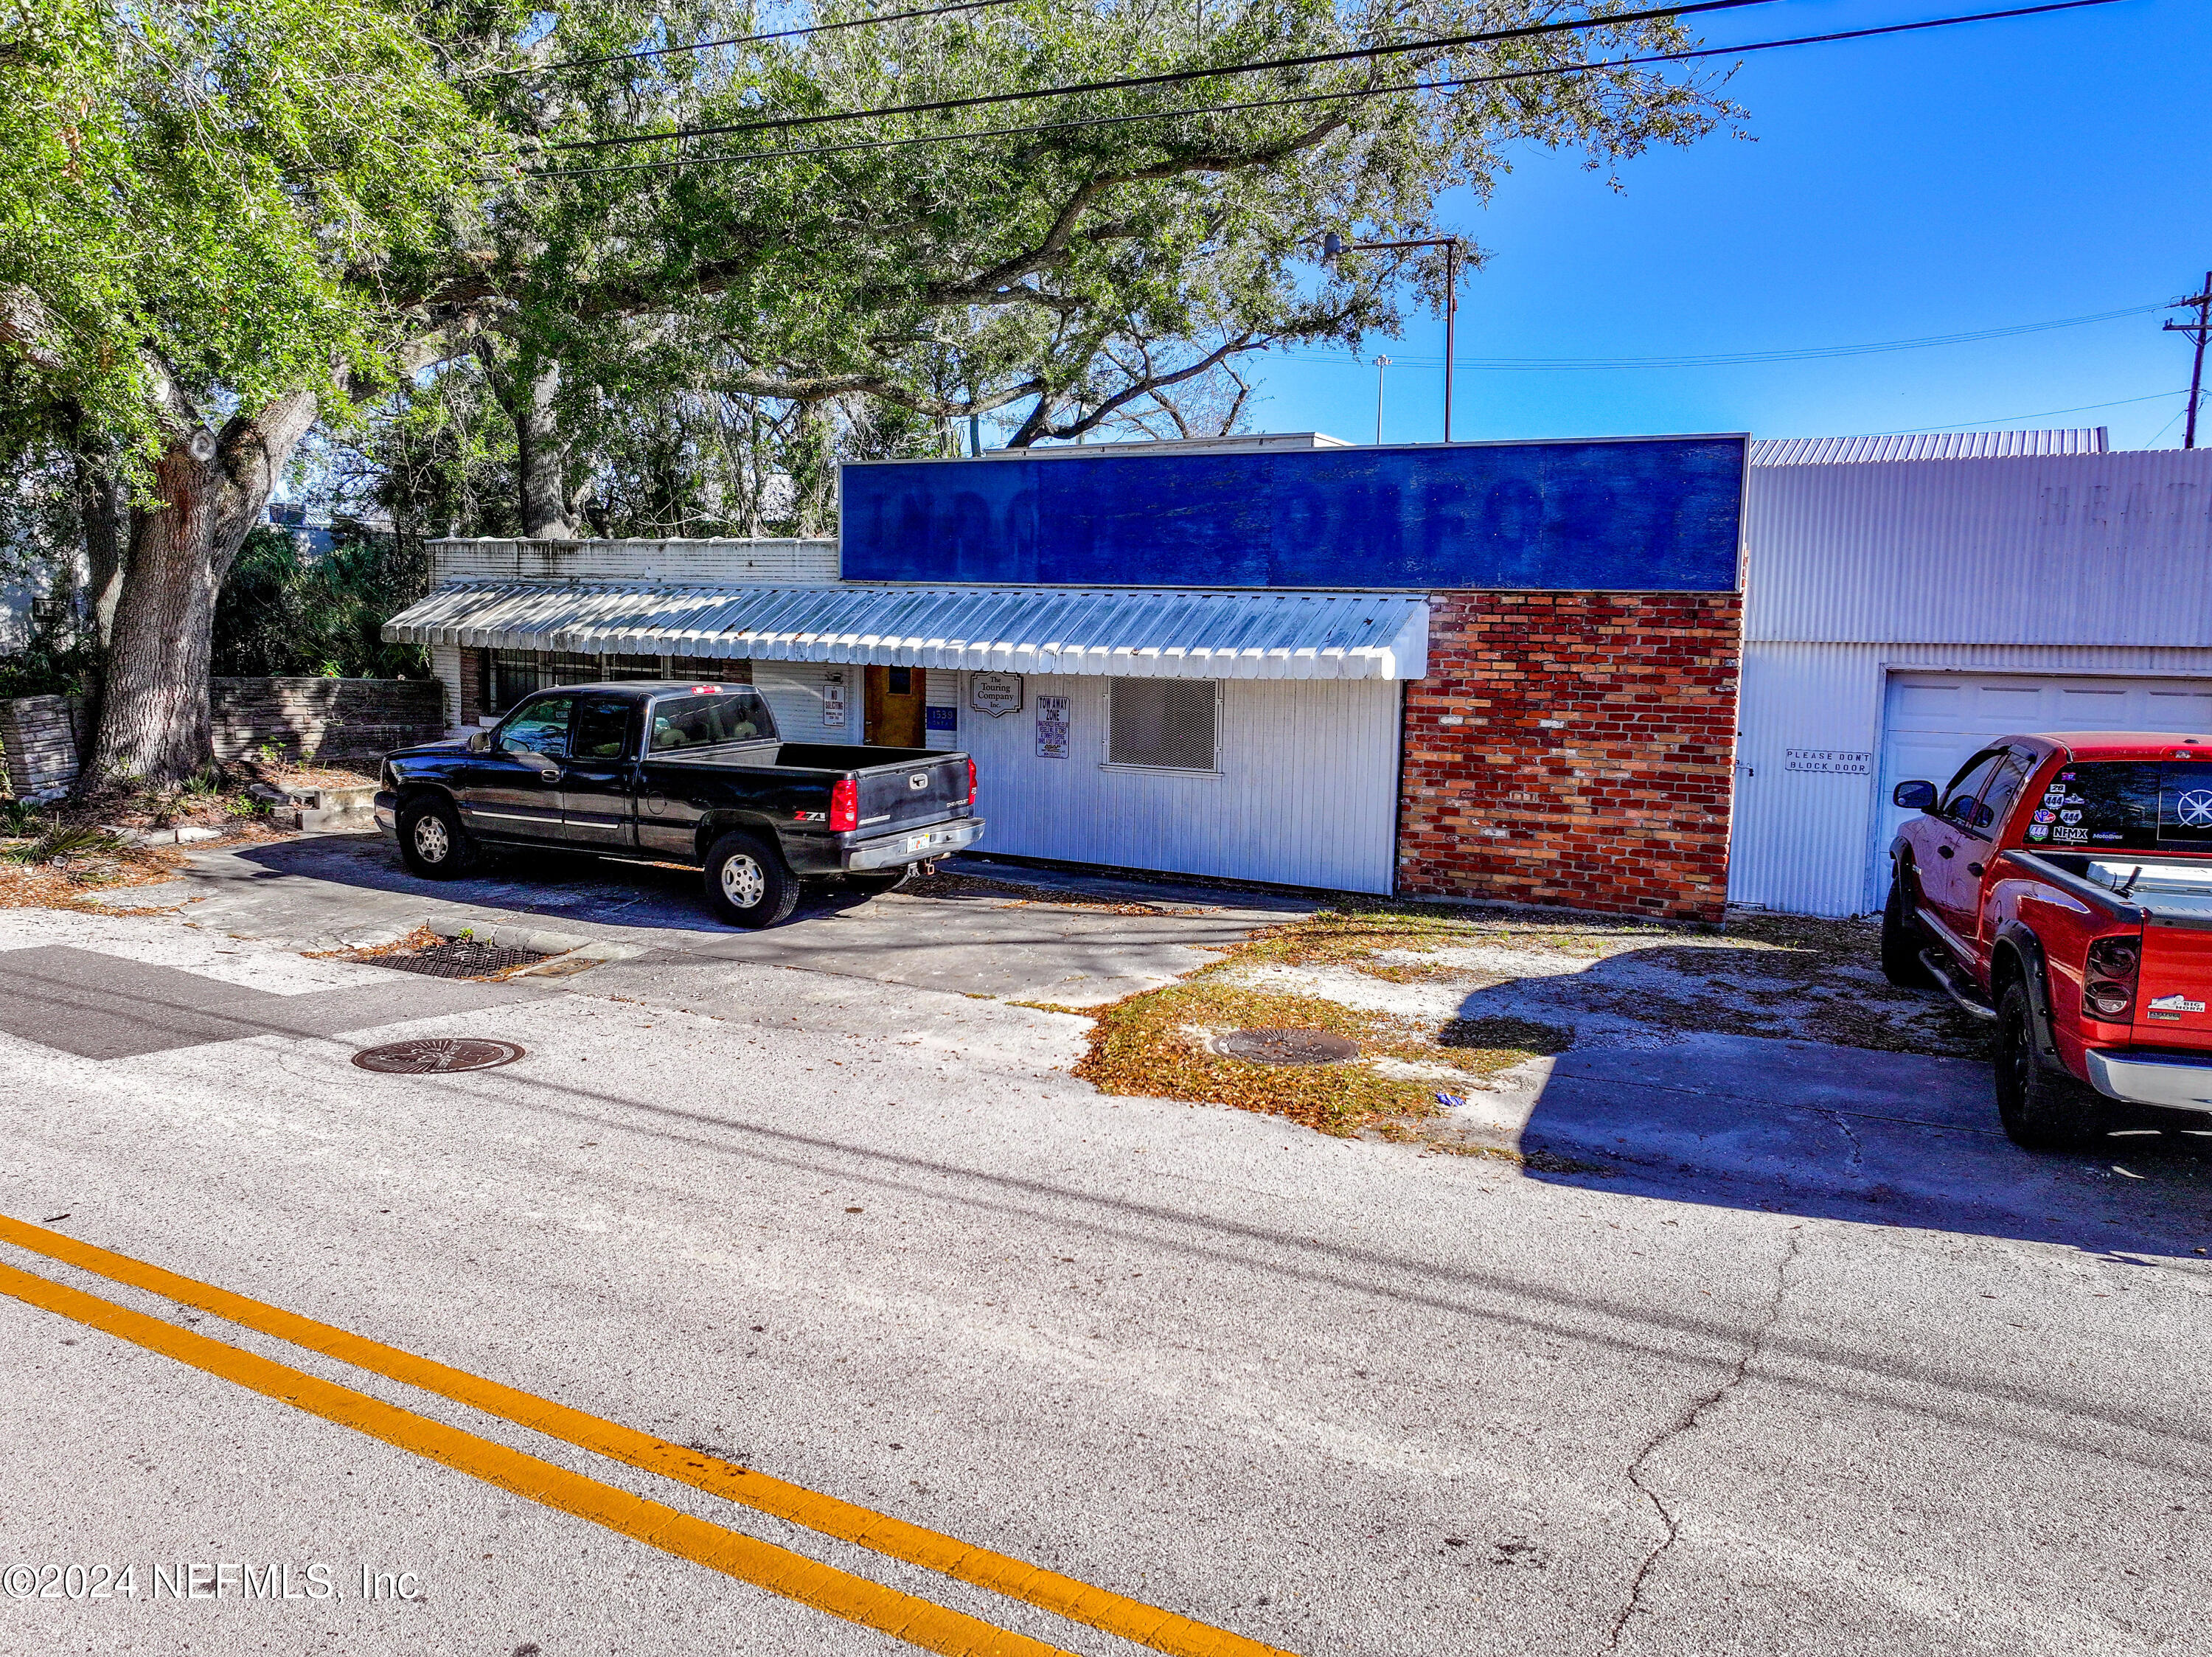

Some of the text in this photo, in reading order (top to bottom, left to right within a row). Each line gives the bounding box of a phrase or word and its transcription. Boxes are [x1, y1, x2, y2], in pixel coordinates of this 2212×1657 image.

[981, 683, 1010, 693] Touring
[831, 690, 838, 700] NO
[978, 691, 1014, 701] Company
[1040, 697, 1068, 710] TOW AWAY
[933, 710, 953, 719] 1539
[1046, 709, 1060, 721] ZONE
[1787, 751, 1832, 760] PLEASE
[1790, 762, 1828, 770] BLOCK
[2046, 796, 2062, 805] 444
[794, 810, 826, 820] Z71
[2036, 810, 2049, 822] VP
[2031, 827, 2048, 836] 444
